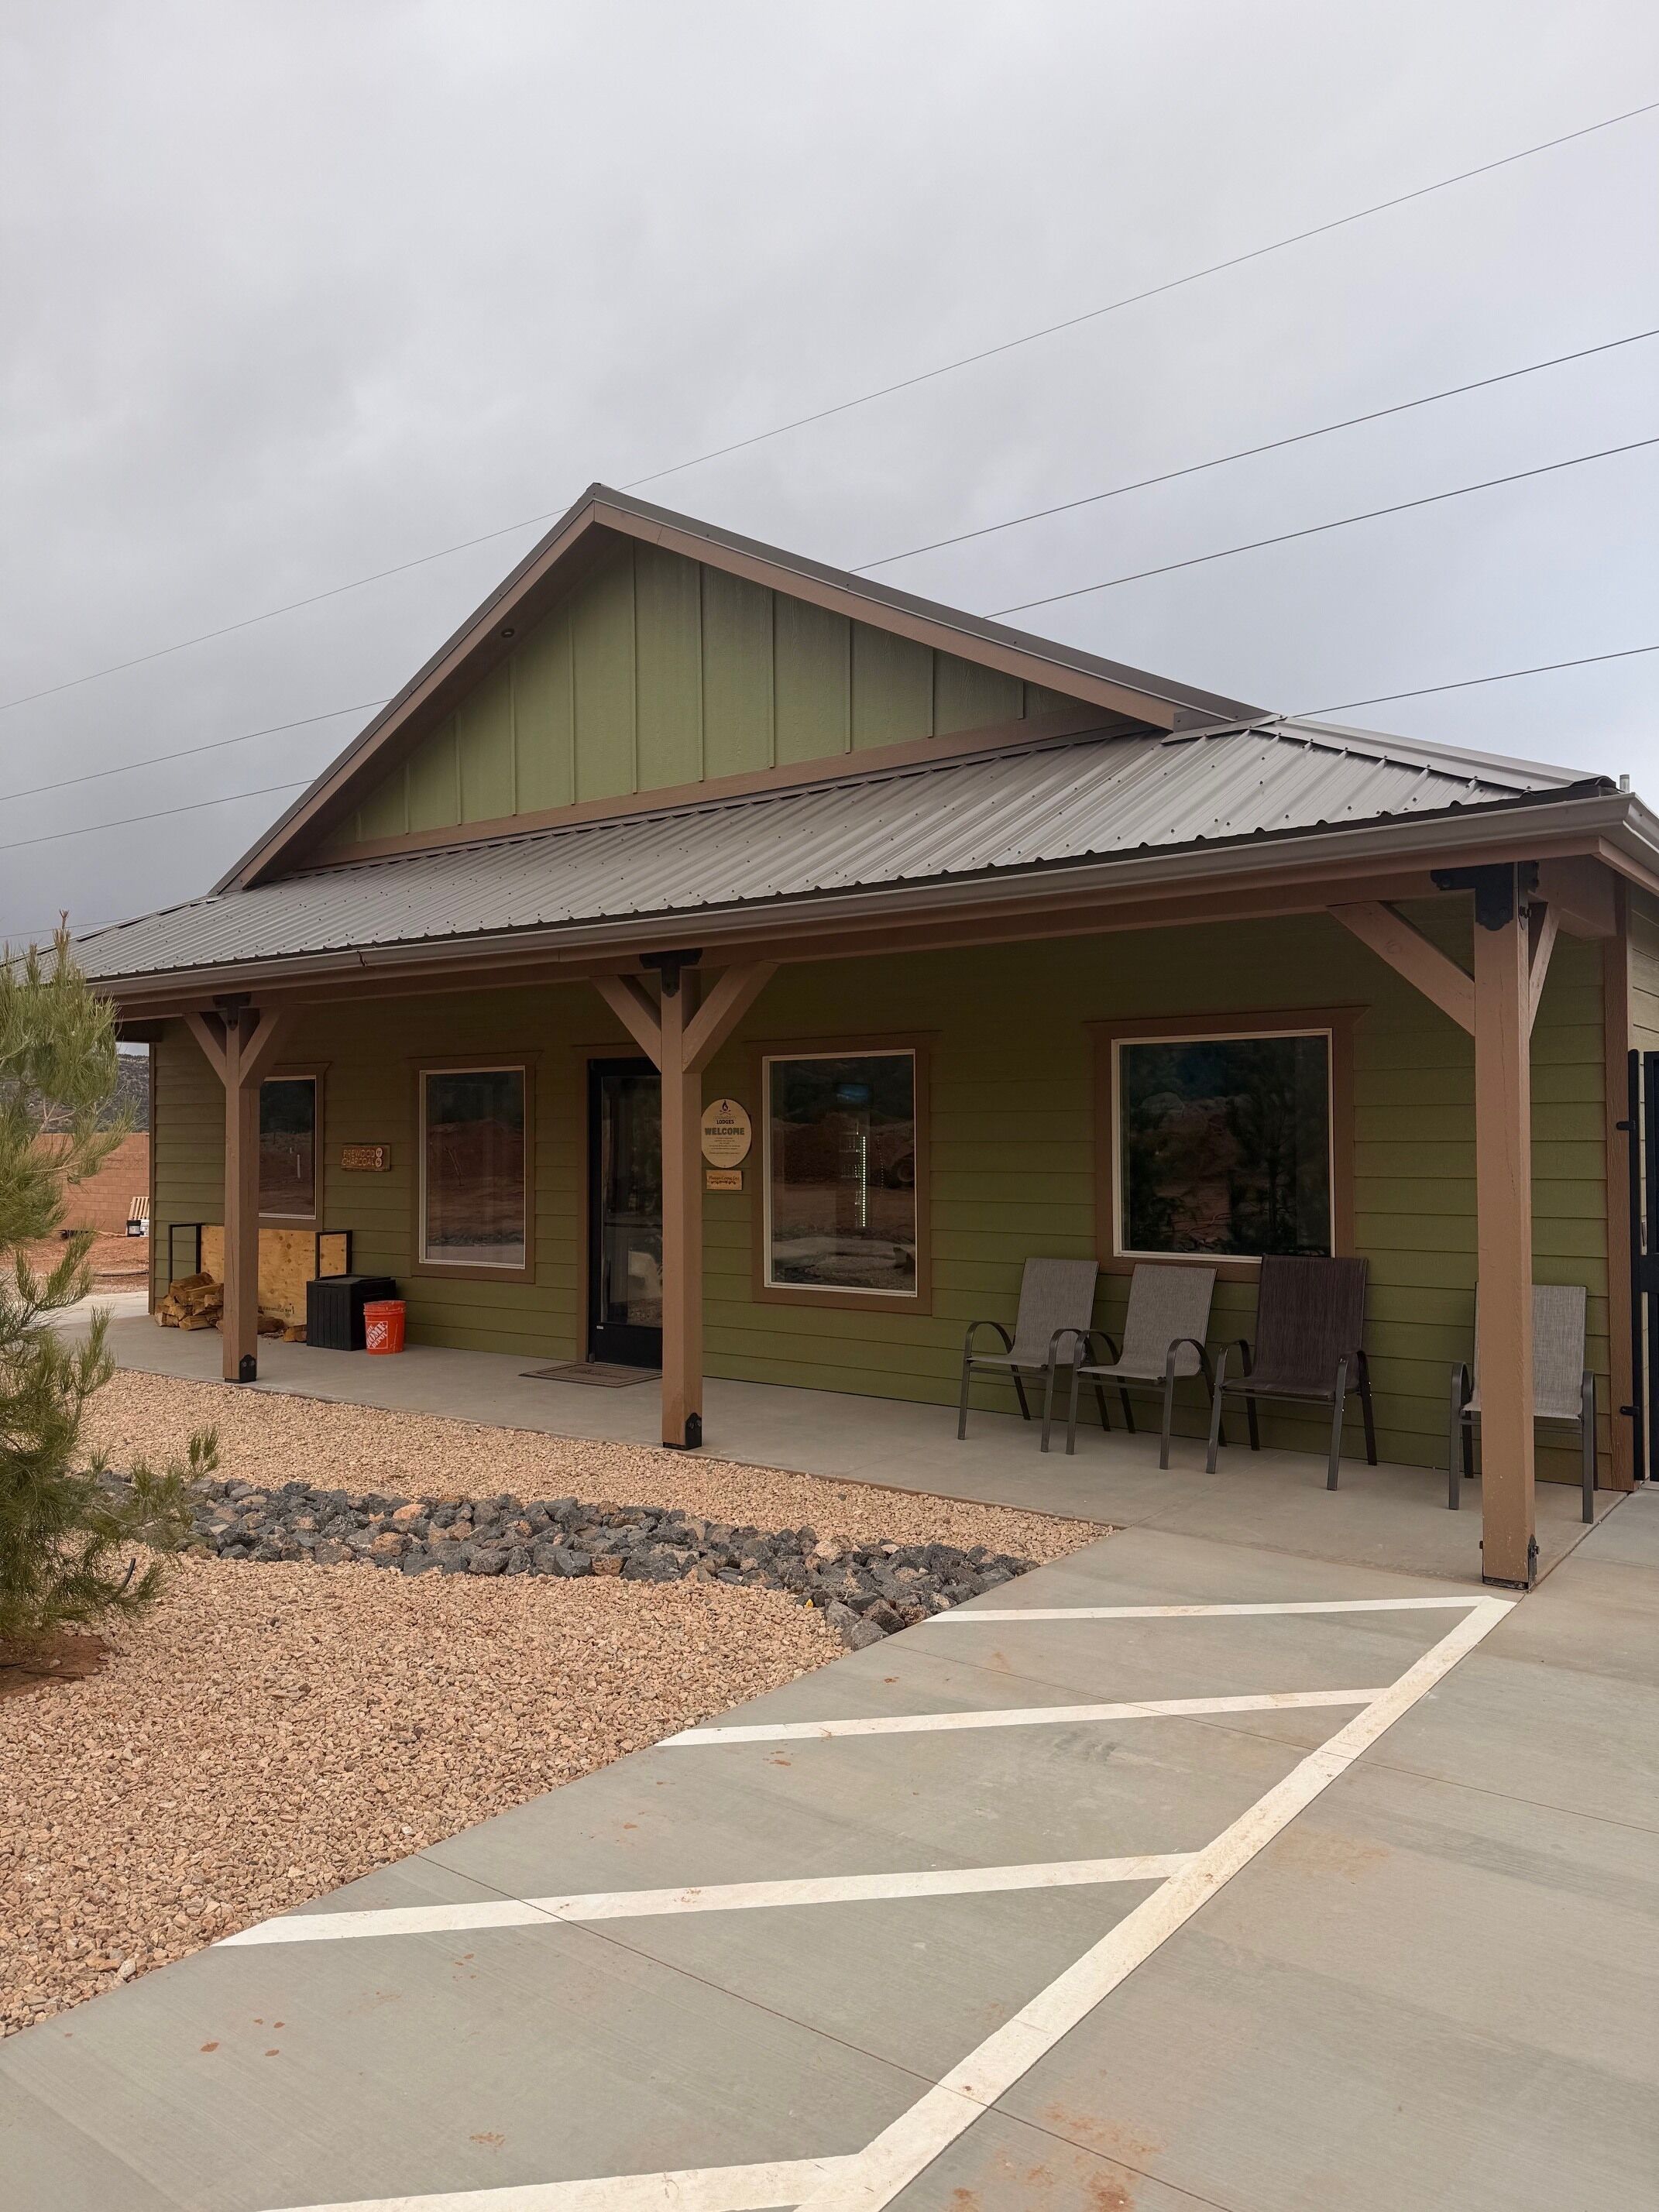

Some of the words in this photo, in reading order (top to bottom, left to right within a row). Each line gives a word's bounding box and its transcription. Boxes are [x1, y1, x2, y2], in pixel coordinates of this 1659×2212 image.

[342, 1158, 375, 1166] CHARCOAL
[366, 1321, 387, 1348] HOME
[372, 1331, 387, 1348] DEPOT
